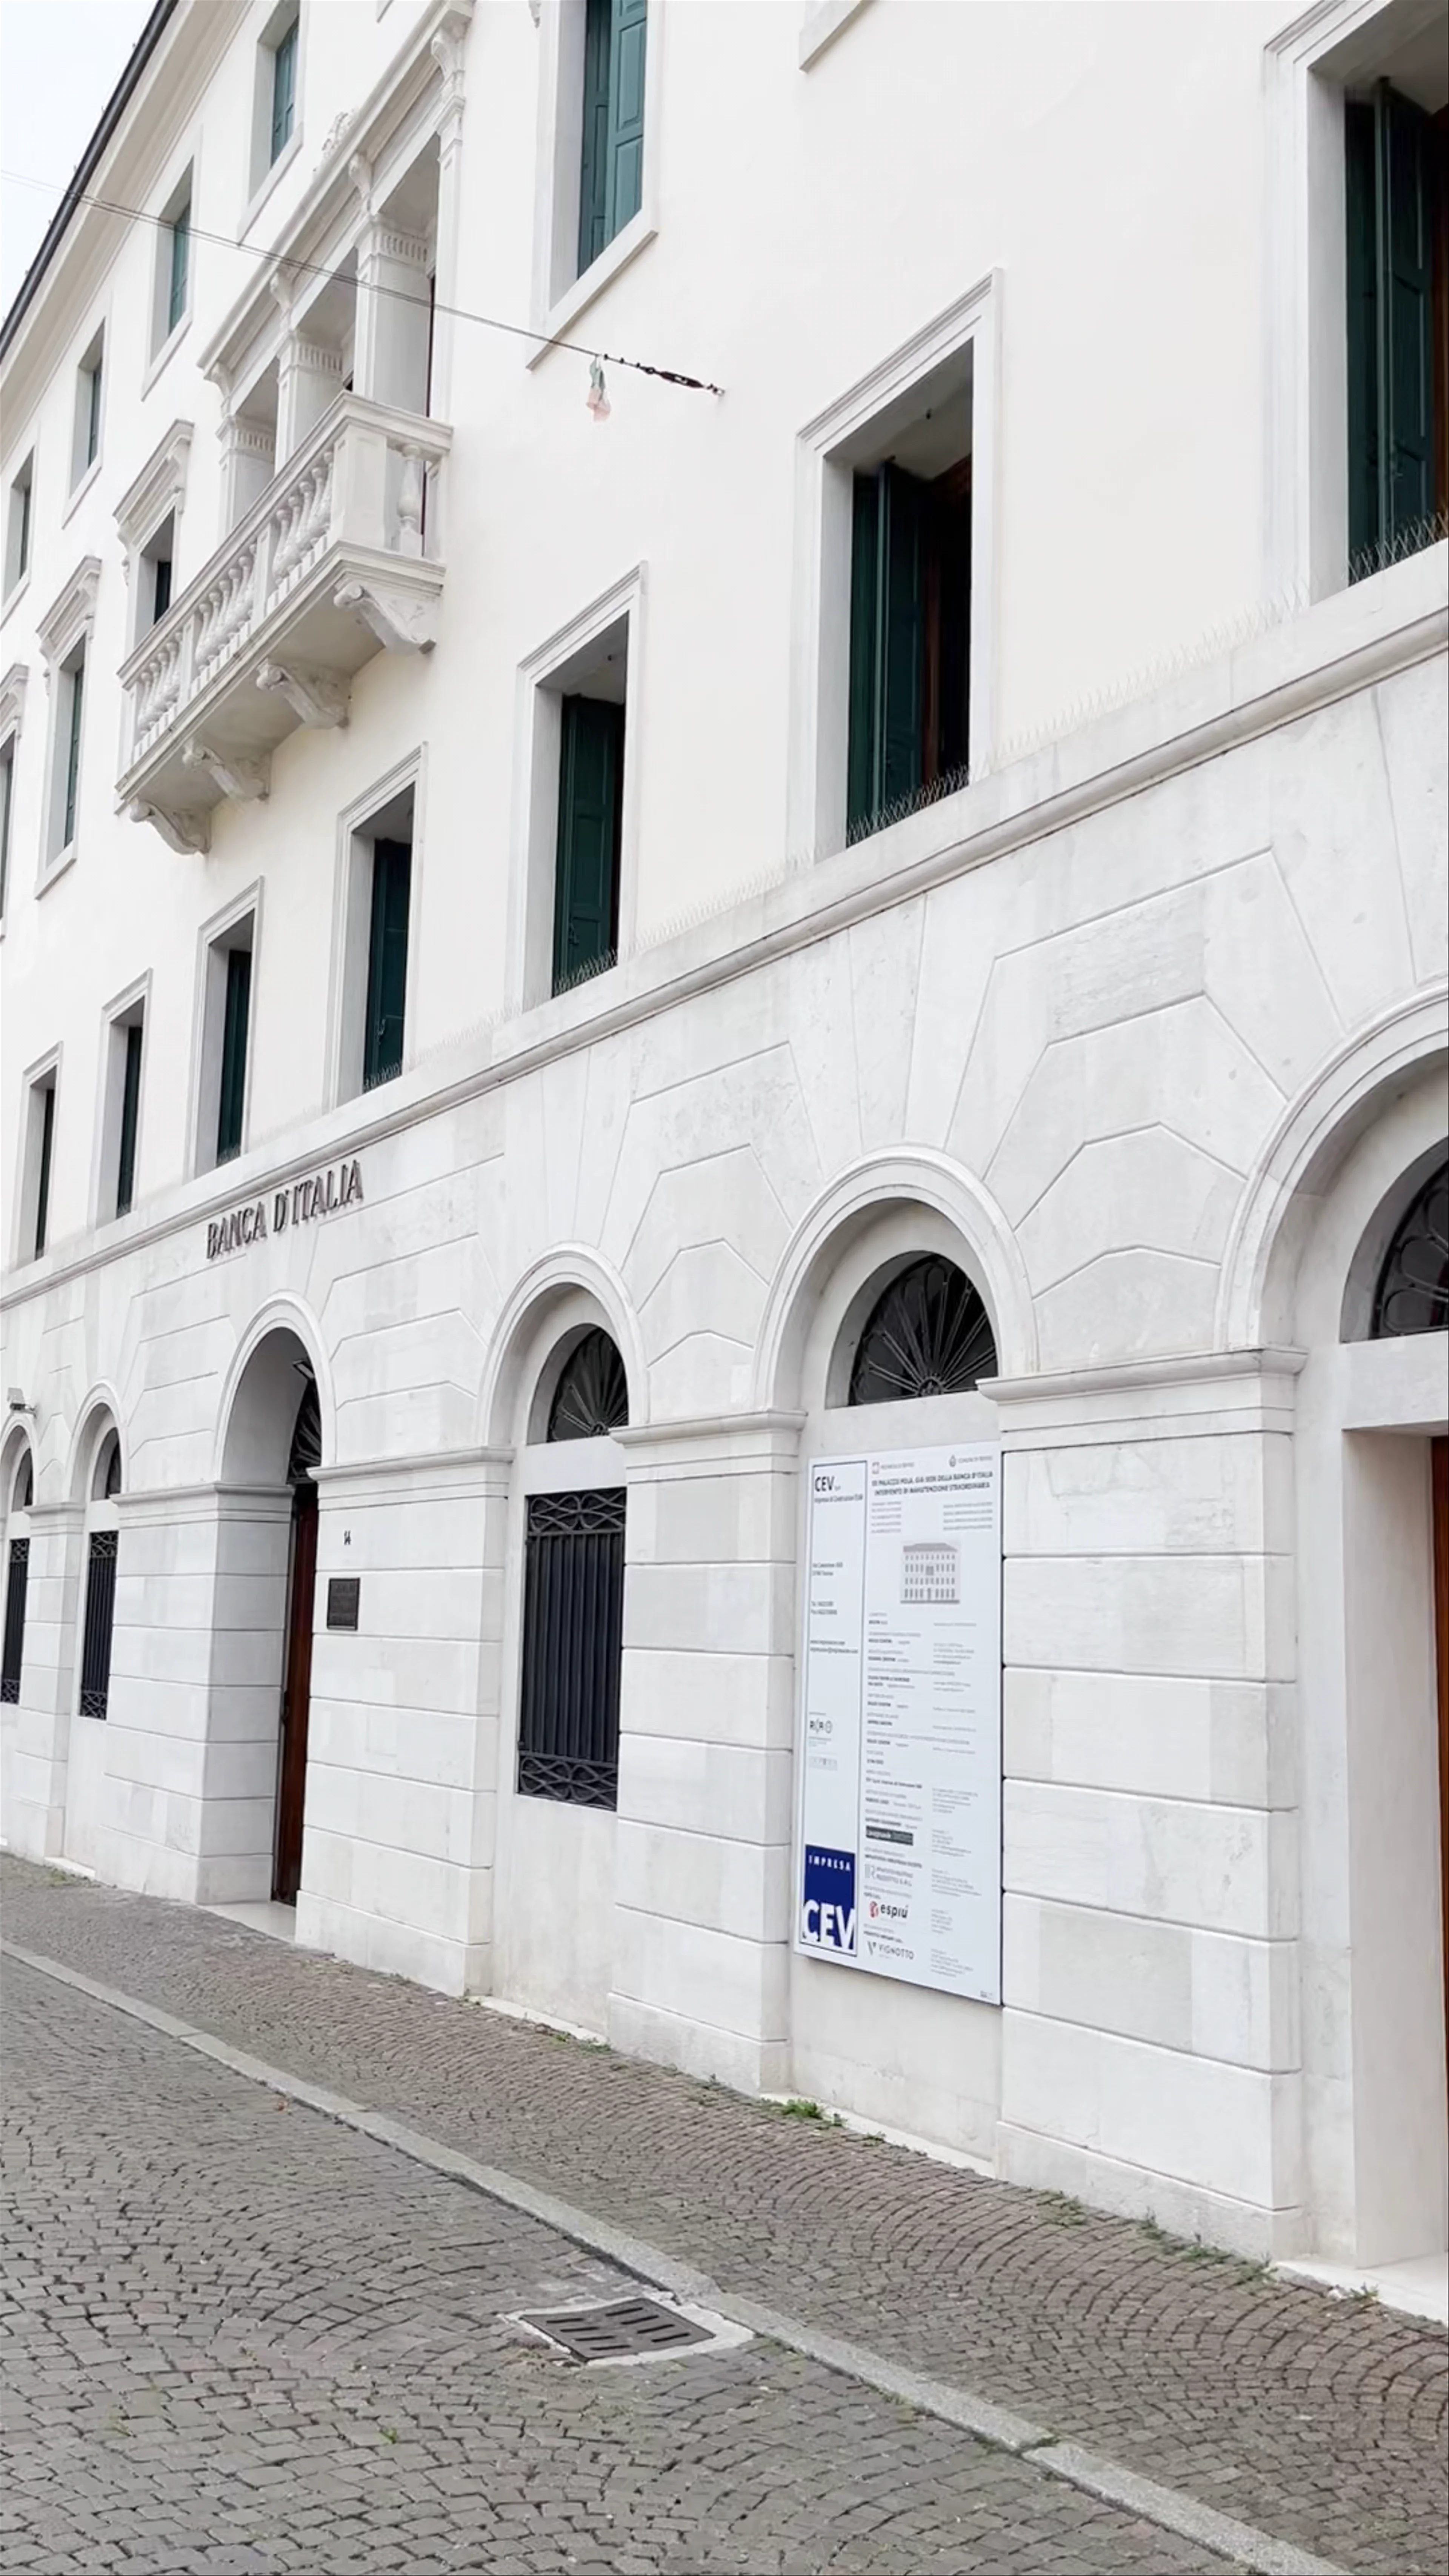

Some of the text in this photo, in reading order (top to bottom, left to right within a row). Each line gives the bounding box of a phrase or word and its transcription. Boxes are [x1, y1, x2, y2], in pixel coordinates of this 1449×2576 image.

[206, 1159, 364, 1259] BANCA D'ITALIA
[815, 1476, 835, 1492] CEV
[808, 1854, 851, 1872] IMPRESA
[803, 1899, 855, 1950] CEV
